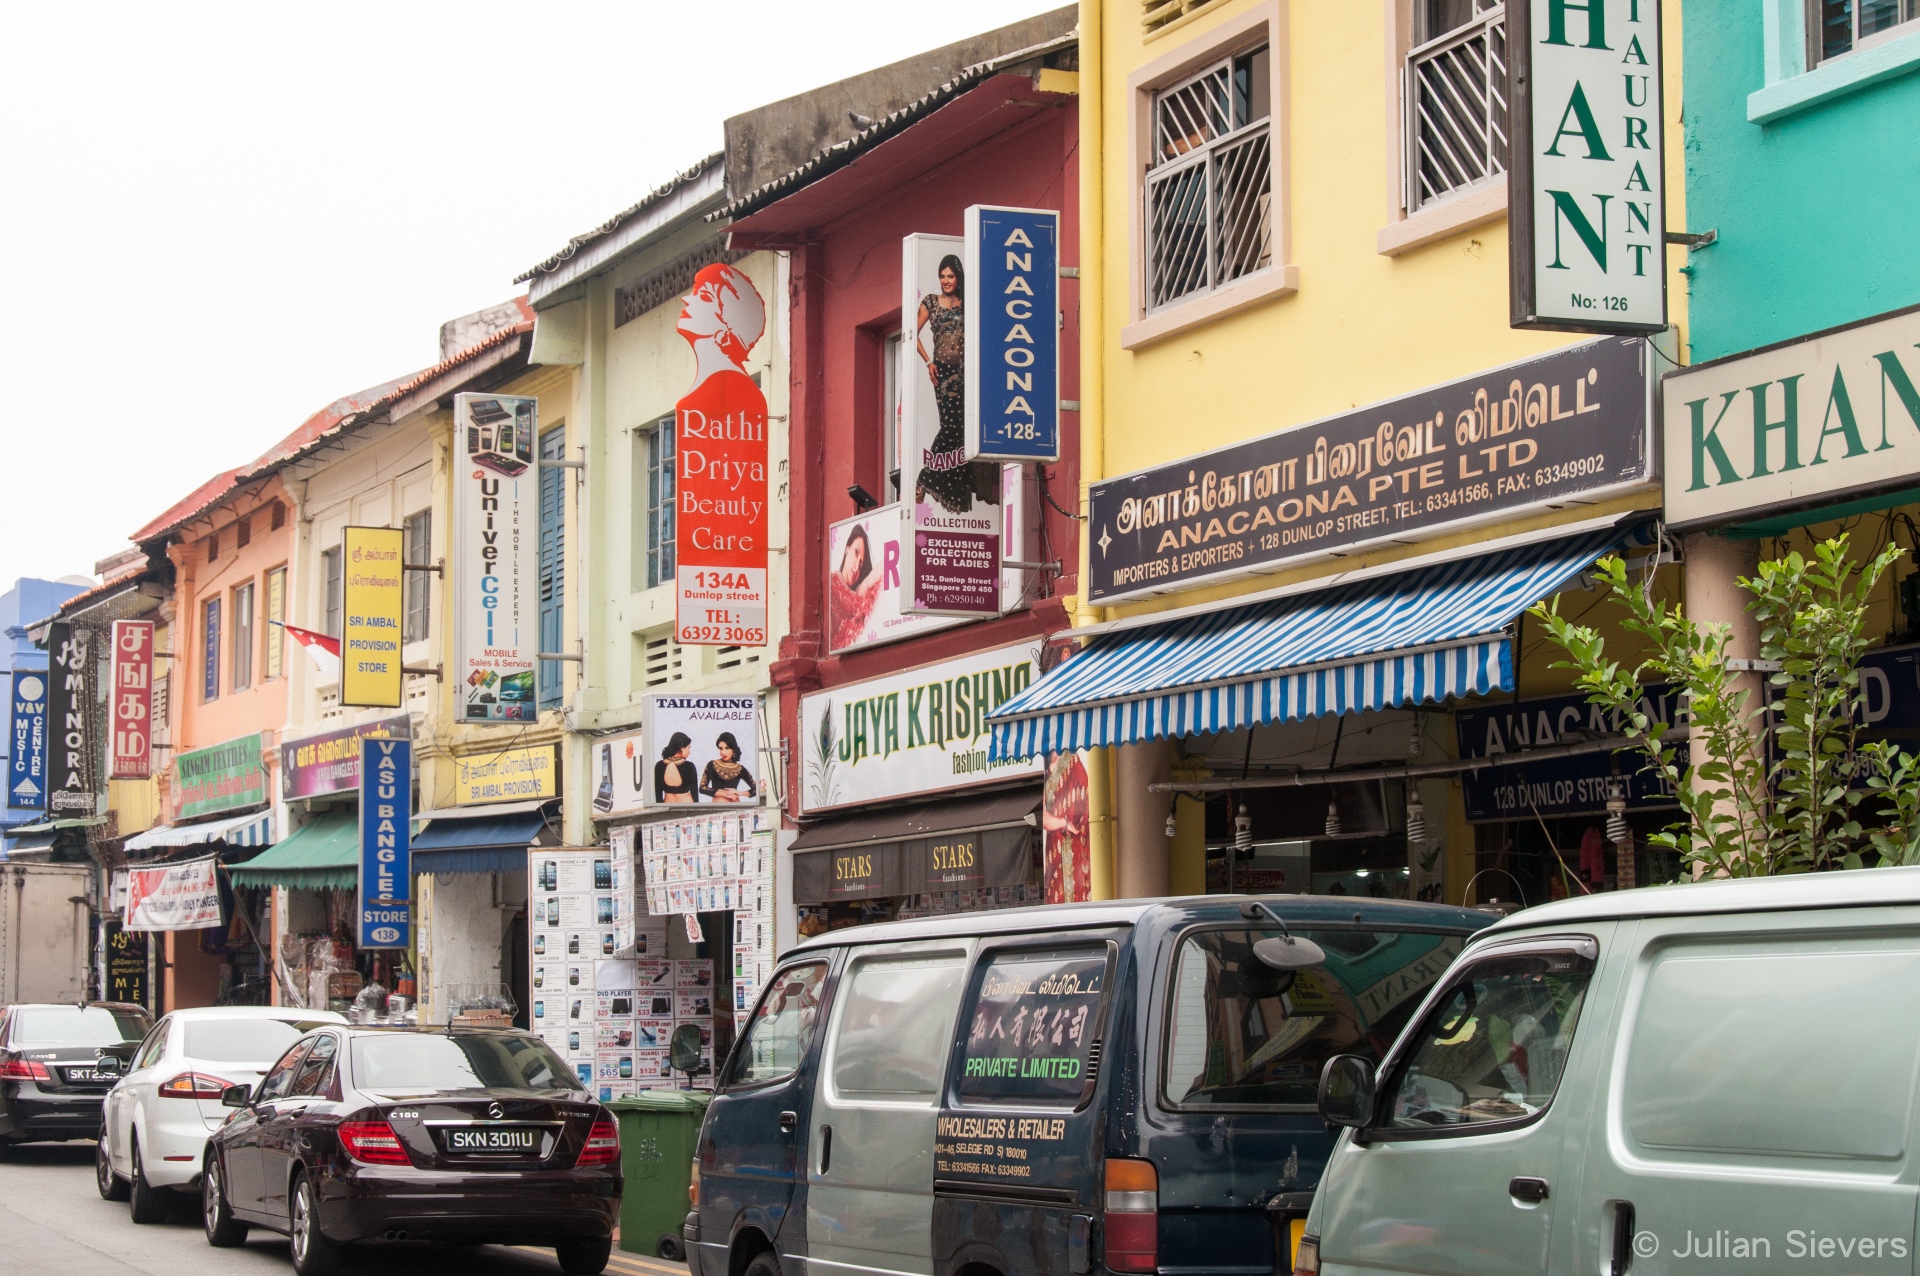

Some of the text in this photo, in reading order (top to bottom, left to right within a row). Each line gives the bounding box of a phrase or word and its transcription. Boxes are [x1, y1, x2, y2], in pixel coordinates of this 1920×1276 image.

[1571, 293, 1628, 311] No: 126
[1004, 228, 1034, 416] ANACAONA
[681, 409, 764, 442] Rathi
[997, 422, 1041, 440] -128-
[1116, 367, 1600, 535] அனாக்கோனா பிரைவேட் லிமிடெட்
[681, 450, 765, 492] Priya
[1156, 439, 1538, 553] ANACAONA PTE LTD
[682, 492, 764, 524] Beauty
[923, 517, 991, 529] COLLECTIONS
[1113, 454, 1605, 586] IMPORTERS & EXPORTERS 128 DUNLOP STREET, TEL: 63341566, FAX: 63349902
[692, 528, 754, 551] Care
[928, 539, 985, 549] EXCLUSIVE
[920, 548, 992, 560] COLLECTIONS
[926, 557, 990, 569] FOR LADIES
[694, 571, 750, 590] 134A
[921, 575, 991, 585] 132, Dunlop Street
[922, 583, 992, 593] Singapore 209 450
[684, 589, 760, 603] Dunlop street
[945, 595, 985, 605] 62950140
[349, 616, 397, 628] SRI AMBAL
[682, 626, 764, 642] 6392 3065
[350, 640, 397, 651] PROVISION
[484, 649, 518, 658] MOBILE
[358, 662, 387, 673] STORE
[469, 658, 533, 668] Sales & Service
[16, 702, 45, 714] V&V
[656, 698, 753, 709] TAILORING
[689, 711, 752, 721] AVAILABLE
[65, 674, 84, 788] MINORA
[838, 692, 899, 767] JAYA
[16, 716, 43, 776] MUSIC CENTRE
[182, 754, 210, 779] SANGAM
[213, 744, 248, 771] TEXTILES
[952, 748, 987, 775] fashion
[316, 762, 354, 782] VASU BANGLES
[471, 779, 541, 799] SRI AMBAL PROVISIONS
[1494, 774, 1632, 809] 128 DUNLOP STREET
[377, 741, 396, 907] VASU BANGLES
[933, 843, 974, 870] STARS
[837, 854, 872, 880] STARS
[364, 911, 408, 923] STORE
[376, 930, 394, 940] 138
[972, 1005, 1088, 1048] 私人有限公司
[599, 1069, 618, 1077] $65
[965, 1058, 1080, 1078] PRIVATE LIMITED
[937, 1117, 1066, 1140] WHOLESALERS & RETAILER
[956, 1143, 982, 1155] SELEGIE
[984, 1145, 994, 1155] RD
[1006, 1148, 1027, 1159] 180010
[937, 1161, 1030, 1177] TEL: 63341566 FAX: 63349902
